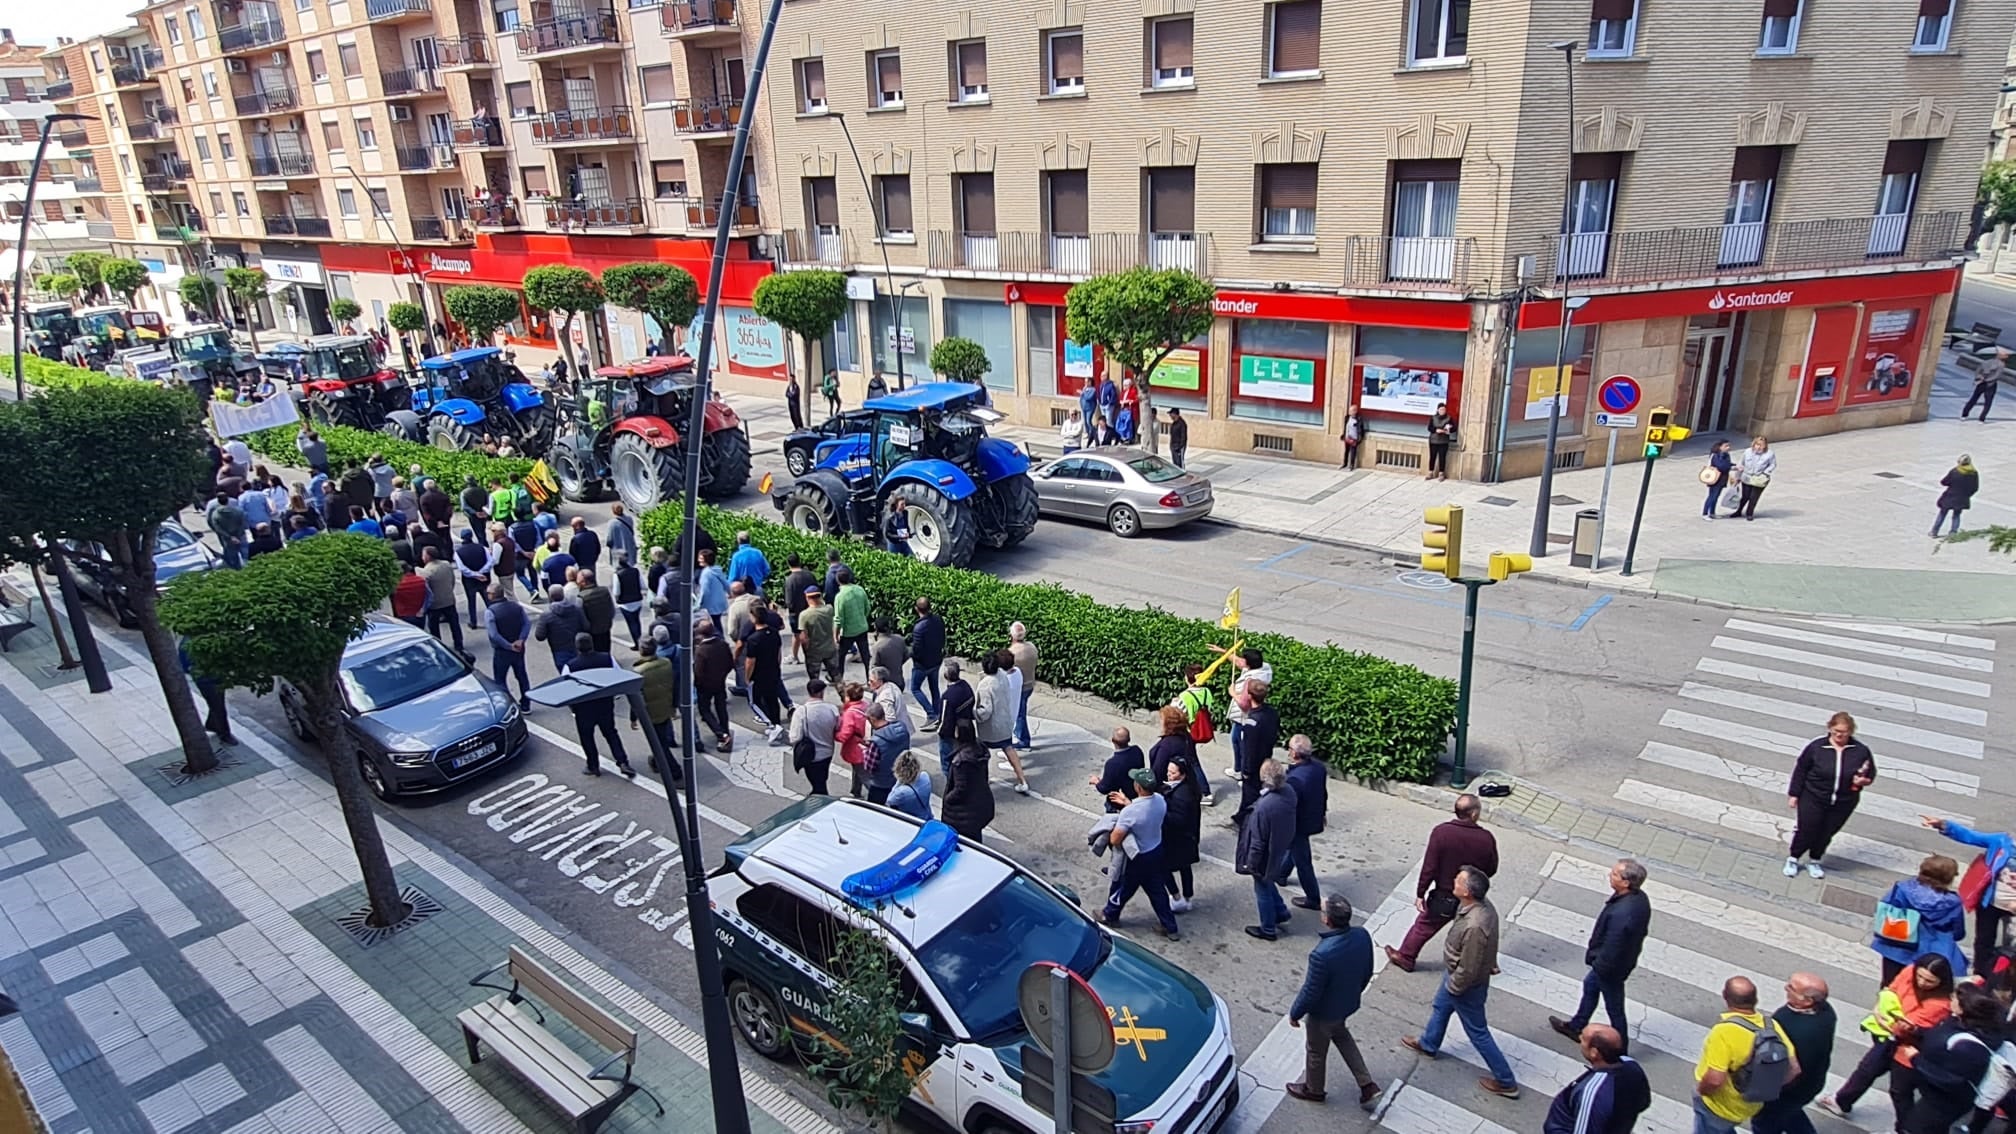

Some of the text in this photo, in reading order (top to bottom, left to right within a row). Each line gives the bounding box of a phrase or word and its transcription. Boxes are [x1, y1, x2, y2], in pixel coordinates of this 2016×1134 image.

[431, 252, 471, 274] Alcampo
[1202, 297, 1259, 314] ntander
[1726, 290, 1794, 308] Santander
[739, 313, 768, 326] Abierto
[736, 328, 756, 347] 365
[467, 773, 695, 950] ESERVADO
[916, 855, 939, 874] GUARDIA
